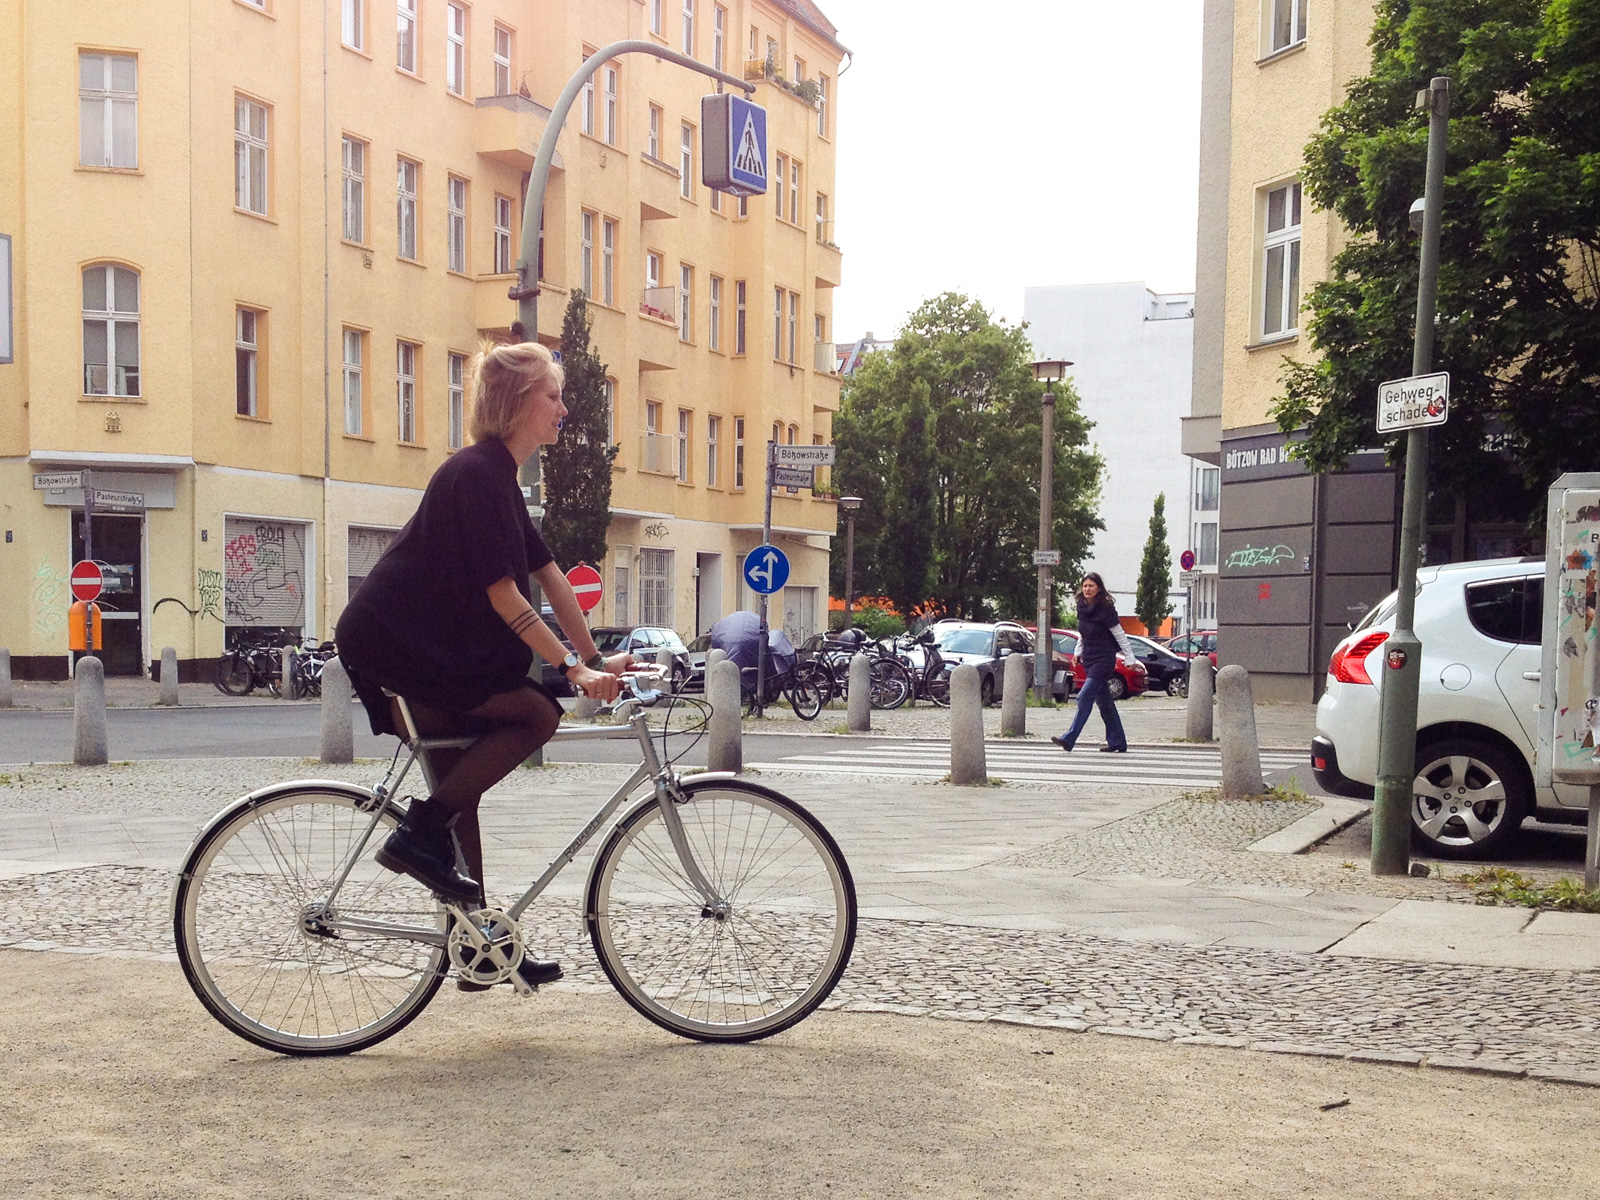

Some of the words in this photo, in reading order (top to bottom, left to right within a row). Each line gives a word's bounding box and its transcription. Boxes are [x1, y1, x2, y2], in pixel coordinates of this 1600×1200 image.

[1385, 386, 1440, 404] Gehweg-
[1386, 404, 1429, 423] schade
[781, 449, 829, 461] Bötzowstraße
[1226, 449, 1258, 470] BÖTZOW
[1260, 447, 1277, 465] RAD
